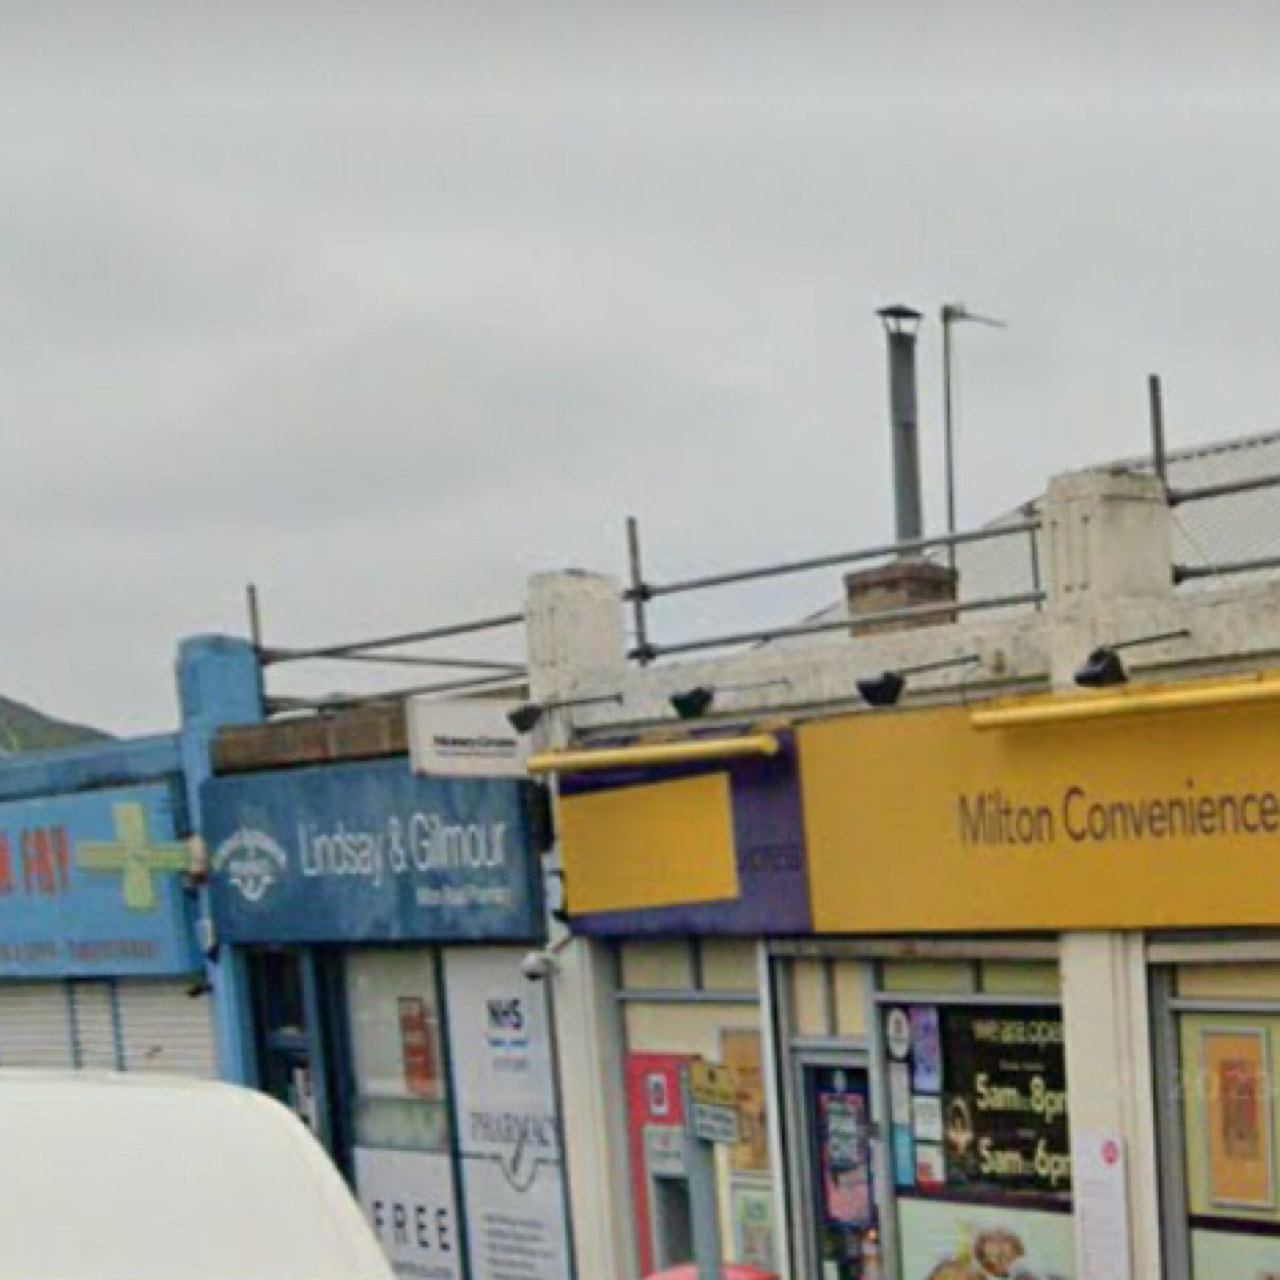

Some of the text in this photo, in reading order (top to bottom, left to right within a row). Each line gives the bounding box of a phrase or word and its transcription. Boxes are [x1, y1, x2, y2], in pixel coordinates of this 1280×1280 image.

[959, 789, 1053, 844] Milton
[1063, 777, 1280, 842] Convenience
[300, 821, 384, 887] Lindsay
[389, 815, 407, 872] &
[409, 812, 506, 871] Gilmour
[486, 999, 524, 1030] NHS
[373, 1200, 451, 1252] FREE
